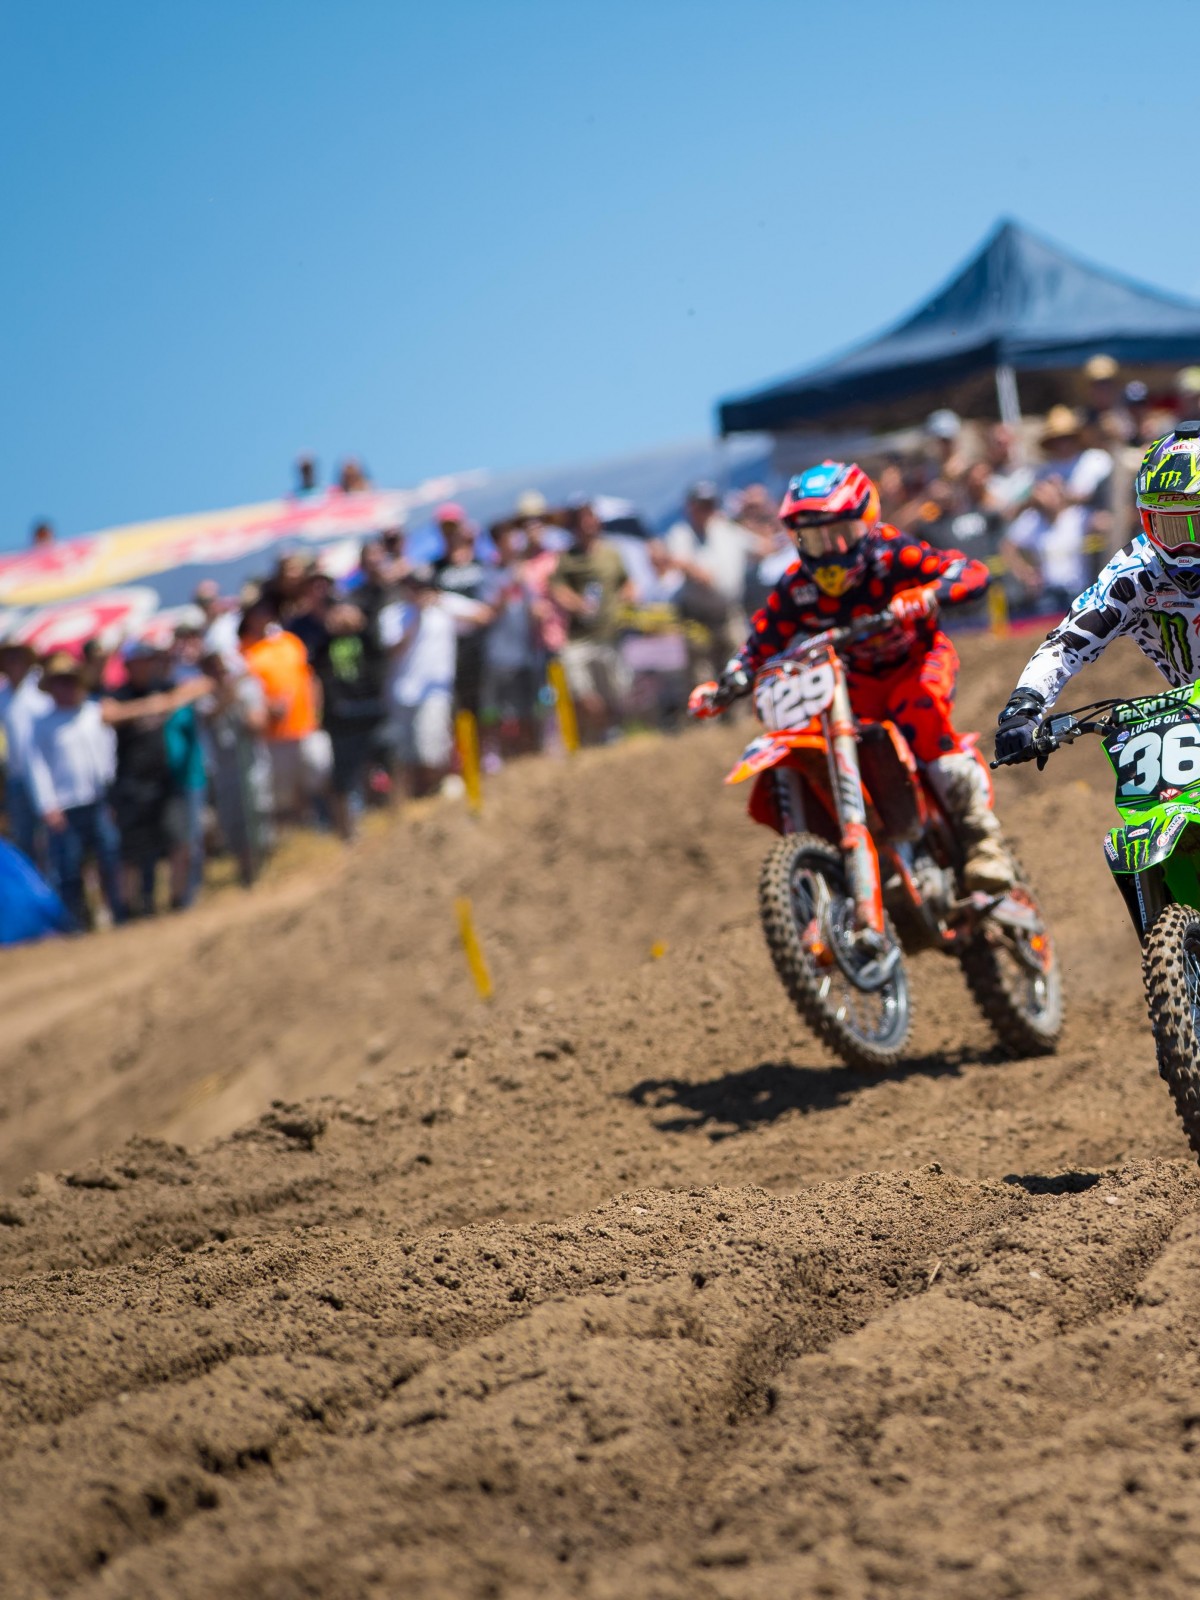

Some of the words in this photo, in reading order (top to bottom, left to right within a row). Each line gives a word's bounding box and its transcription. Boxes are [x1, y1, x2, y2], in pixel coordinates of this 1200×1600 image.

[756, 663, 834, 731] 129
[1119, 686, 1195, 723] RENTHA
[1130, 717, 1161, 737] LUCAS
[1163, 713, 1182, 725] OIL
